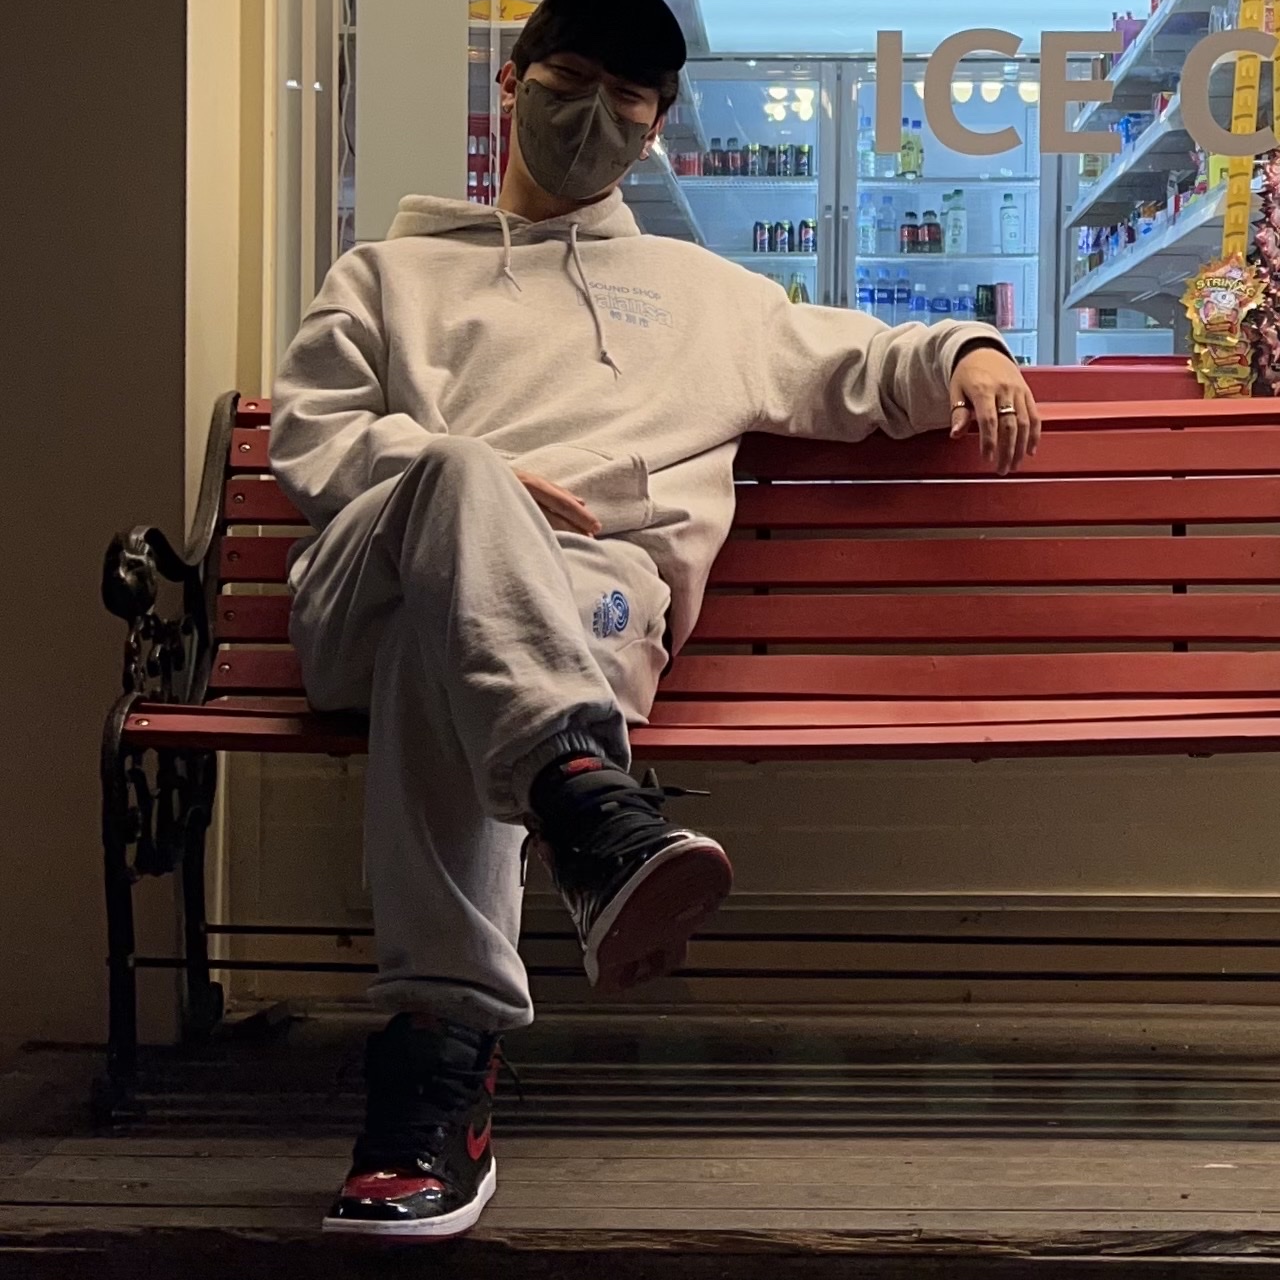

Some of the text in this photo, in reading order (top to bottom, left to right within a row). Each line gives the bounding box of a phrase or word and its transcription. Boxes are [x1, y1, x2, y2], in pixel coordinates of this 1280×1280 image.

[876, 30, 1122, 157] ICE
[588, 281, 662, 300] SOUND SHOP
